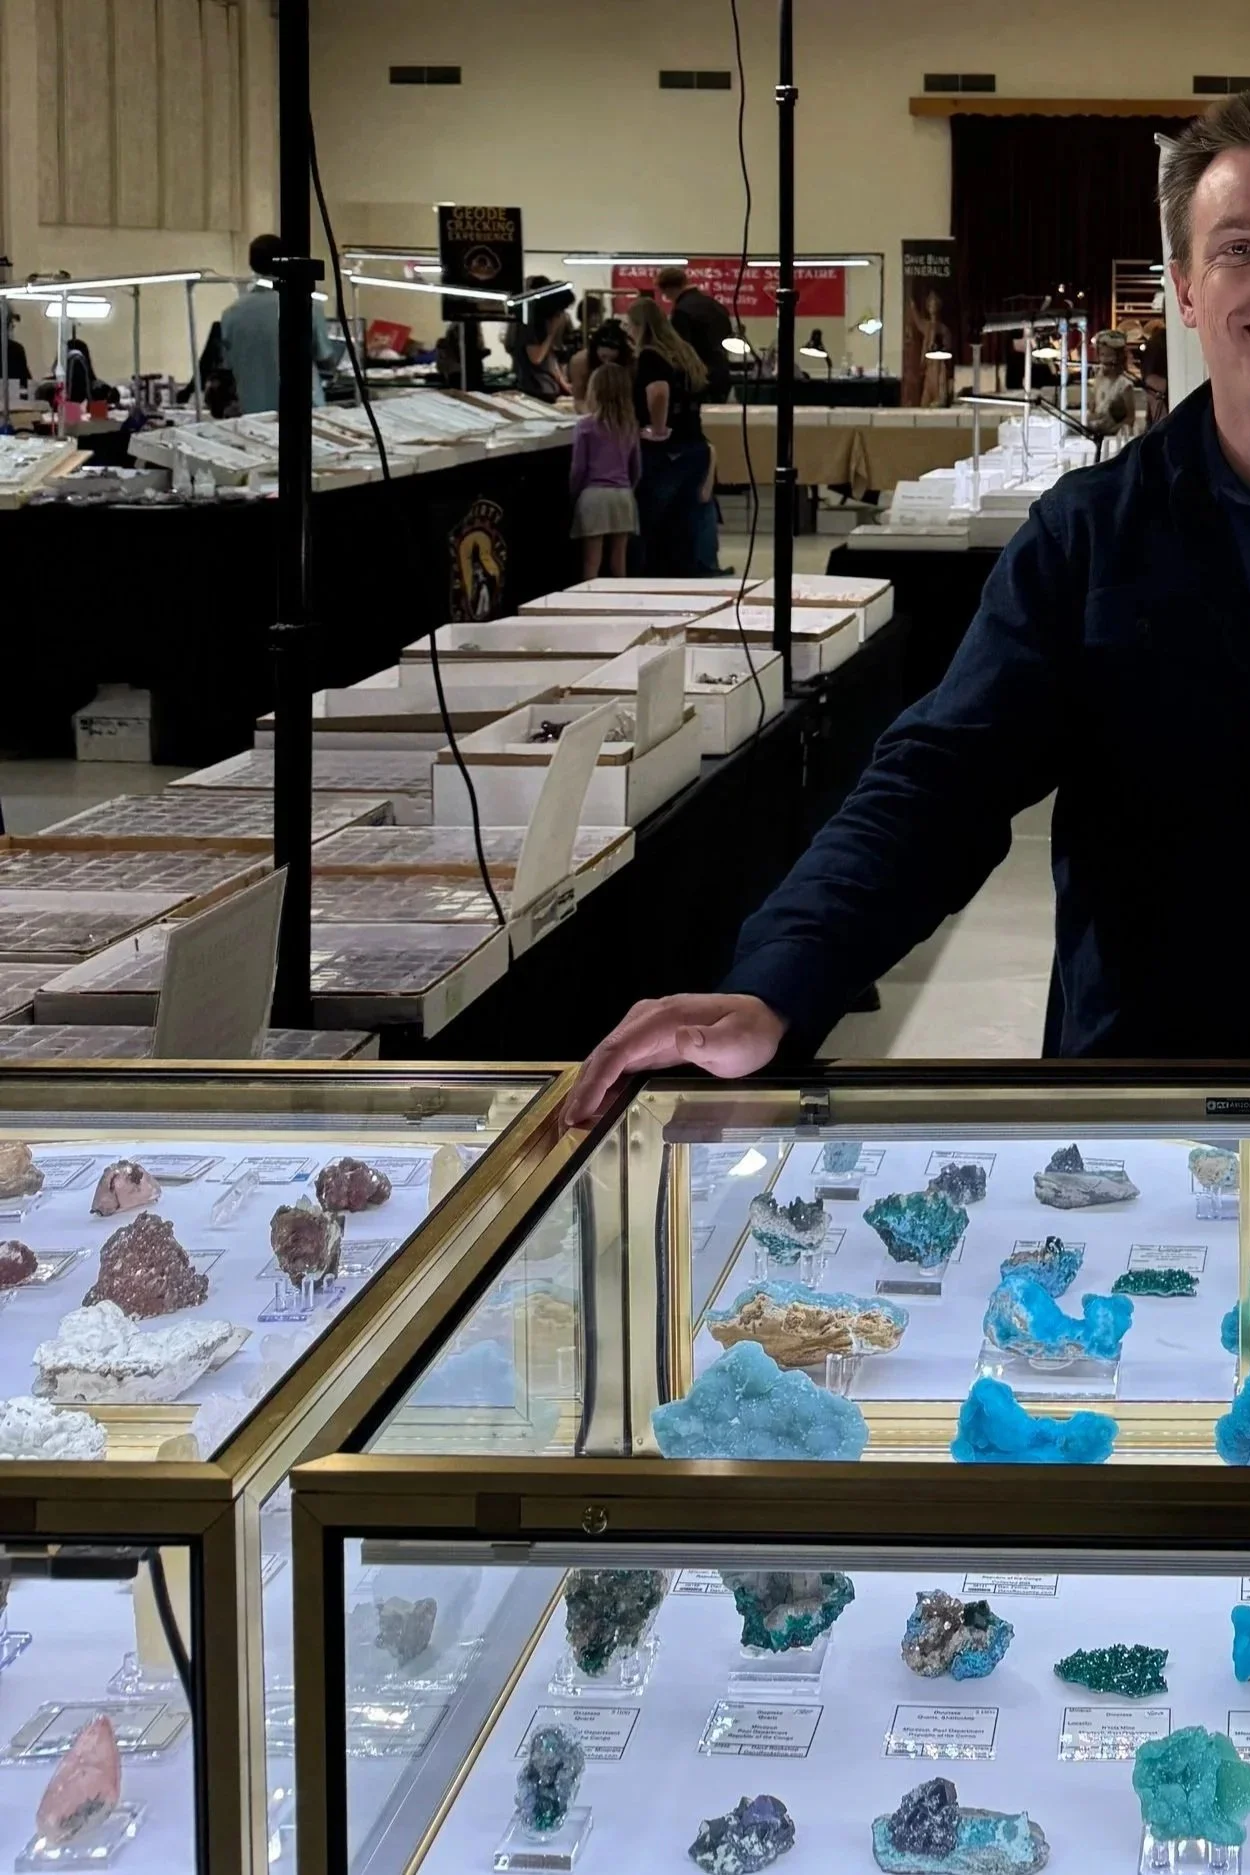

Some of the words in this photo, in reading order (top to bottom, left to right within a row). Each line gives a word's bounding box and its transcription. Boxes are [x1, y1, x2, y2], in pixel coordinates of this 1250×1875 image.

[453, 207, 507, 220] GEODE
[446, 220, 515, 232] CRACKING
[904, 266, 951, 277] MINERALS
